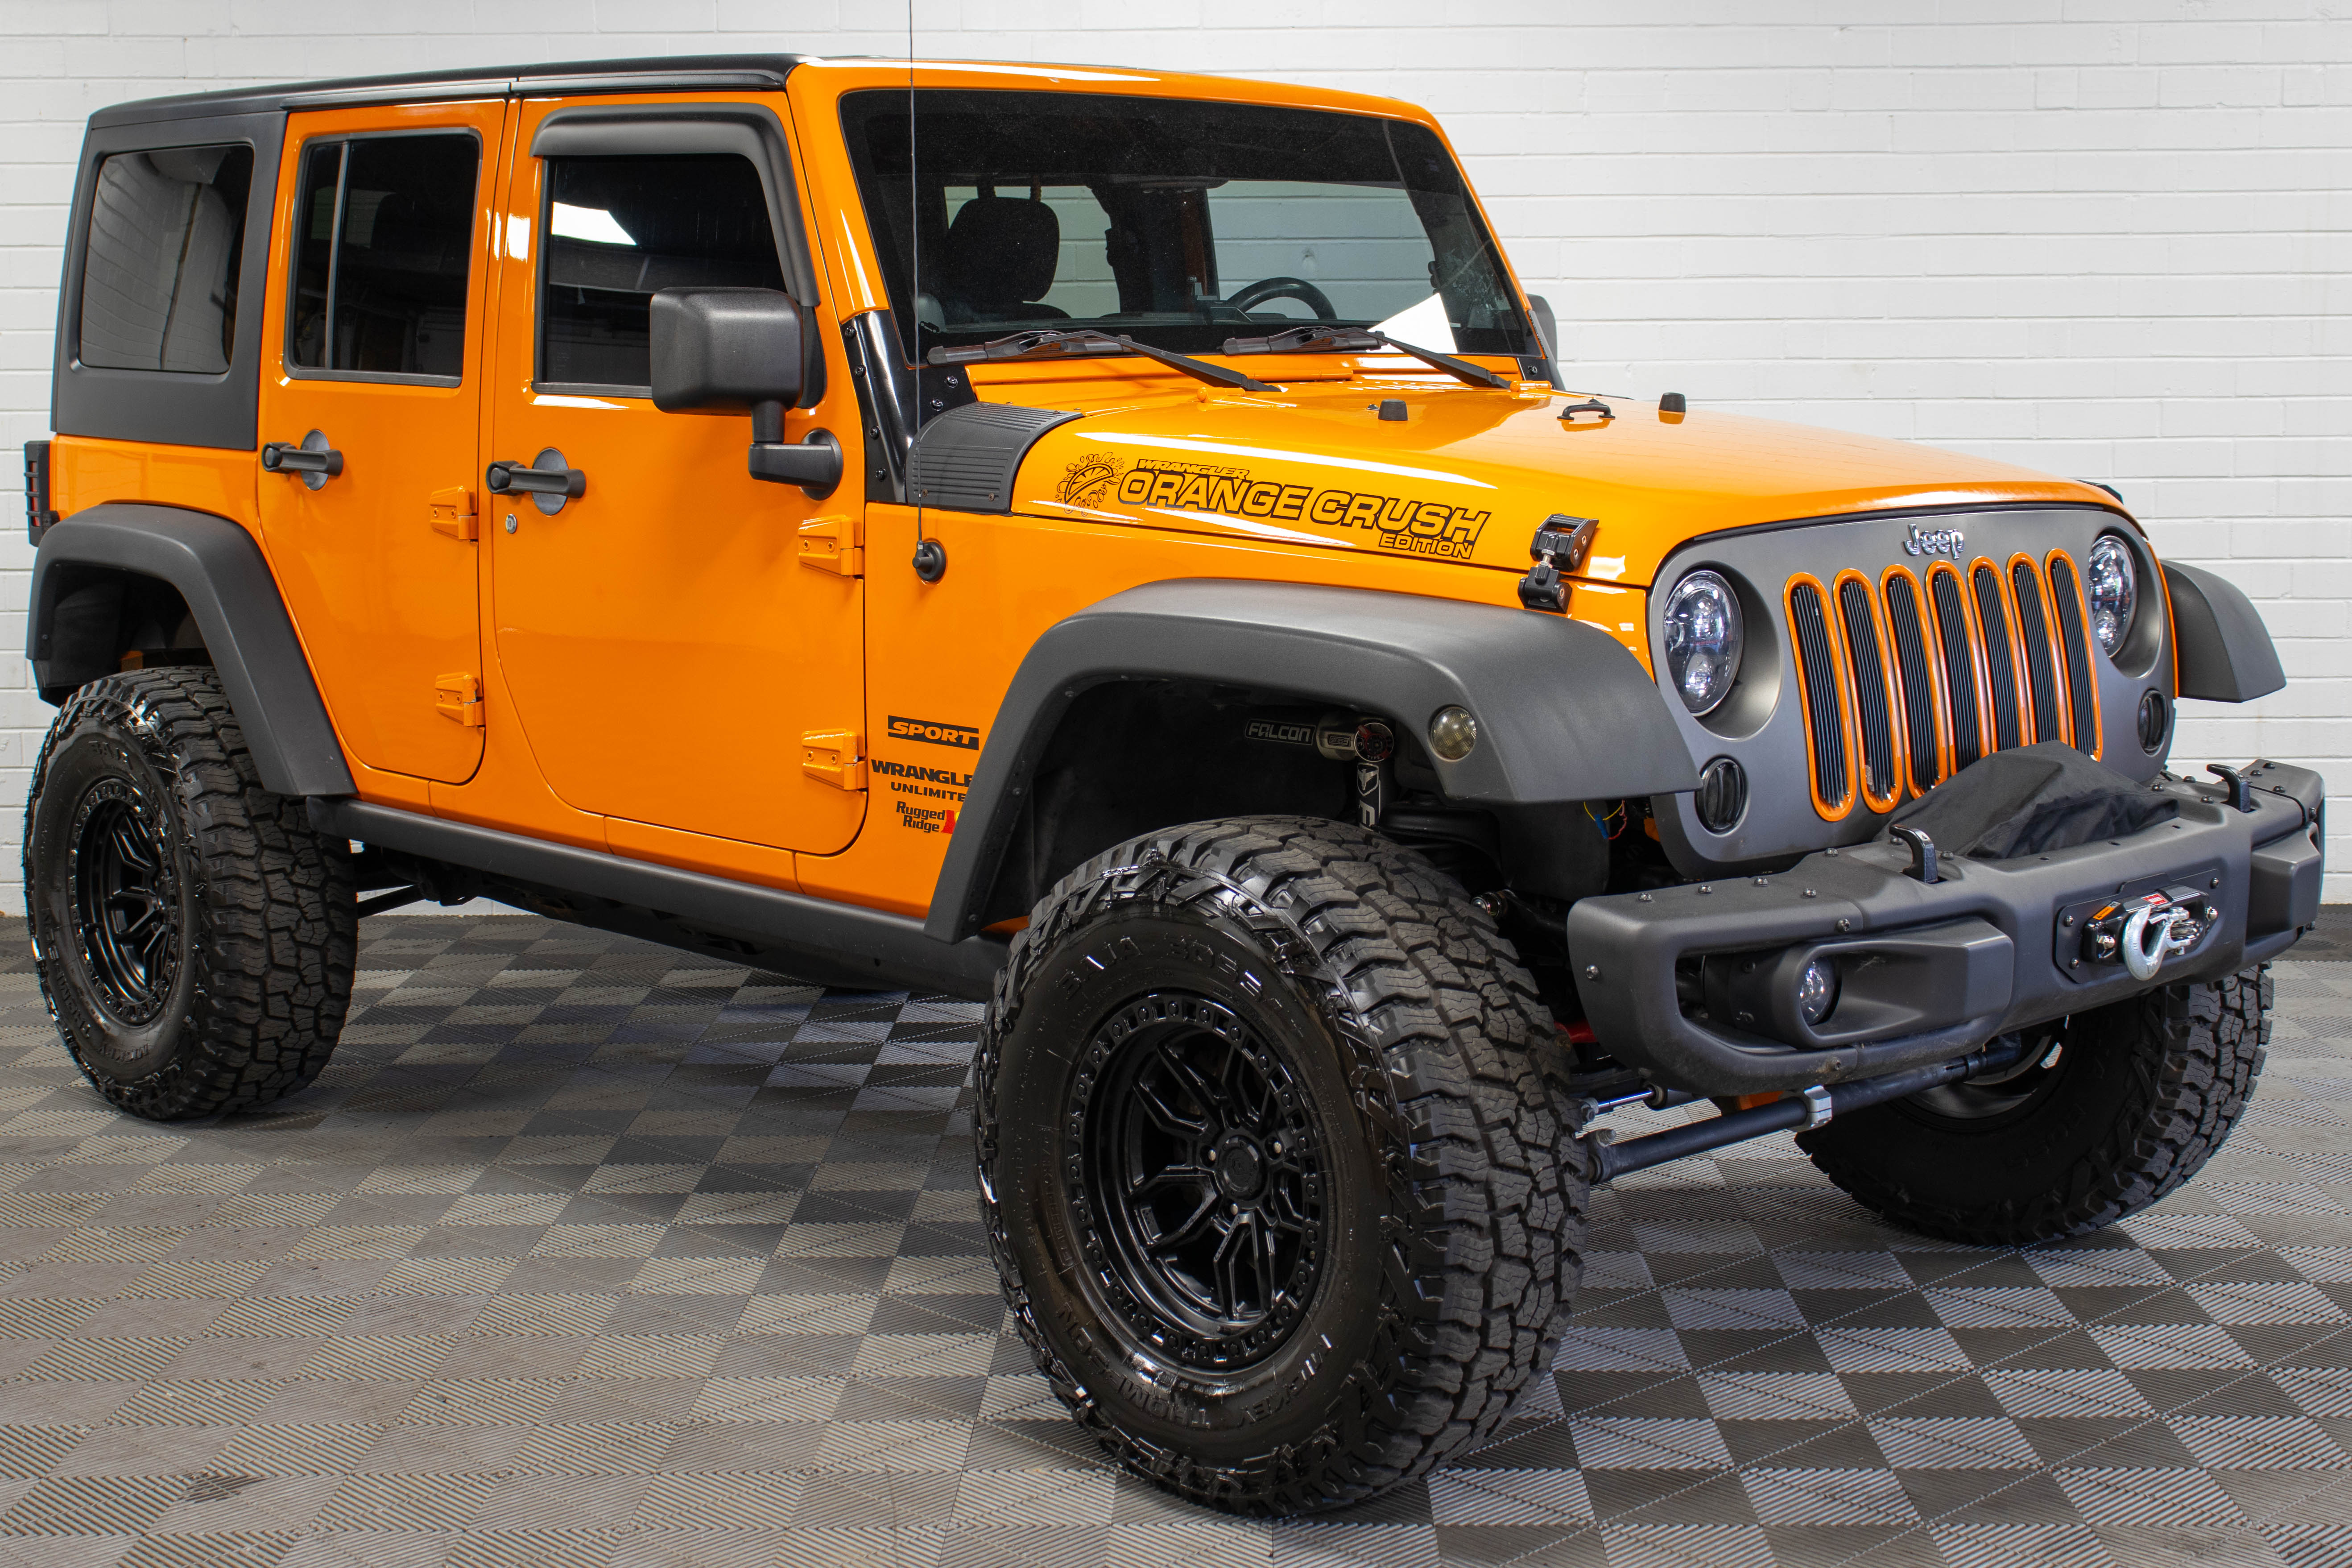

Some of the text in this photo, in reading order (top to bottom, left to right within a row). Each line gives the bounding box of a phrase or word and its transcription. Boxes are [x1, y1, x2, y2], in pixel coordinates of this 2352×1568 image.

[1137, 459, 1250, 480] WRANGLER
[1118, 469, 1490, 541] ORANGE CRUSH
[1378, 531, 1473, 559] EDITION
[1903, 523, 1965, 560] Jeep
[890, 721, 979, 745] SPORT
[1248, 722, 1311, 742] FALCON
[896, 801, 946, 820] Rugged
[903, 815, 940, 833] Ridge
